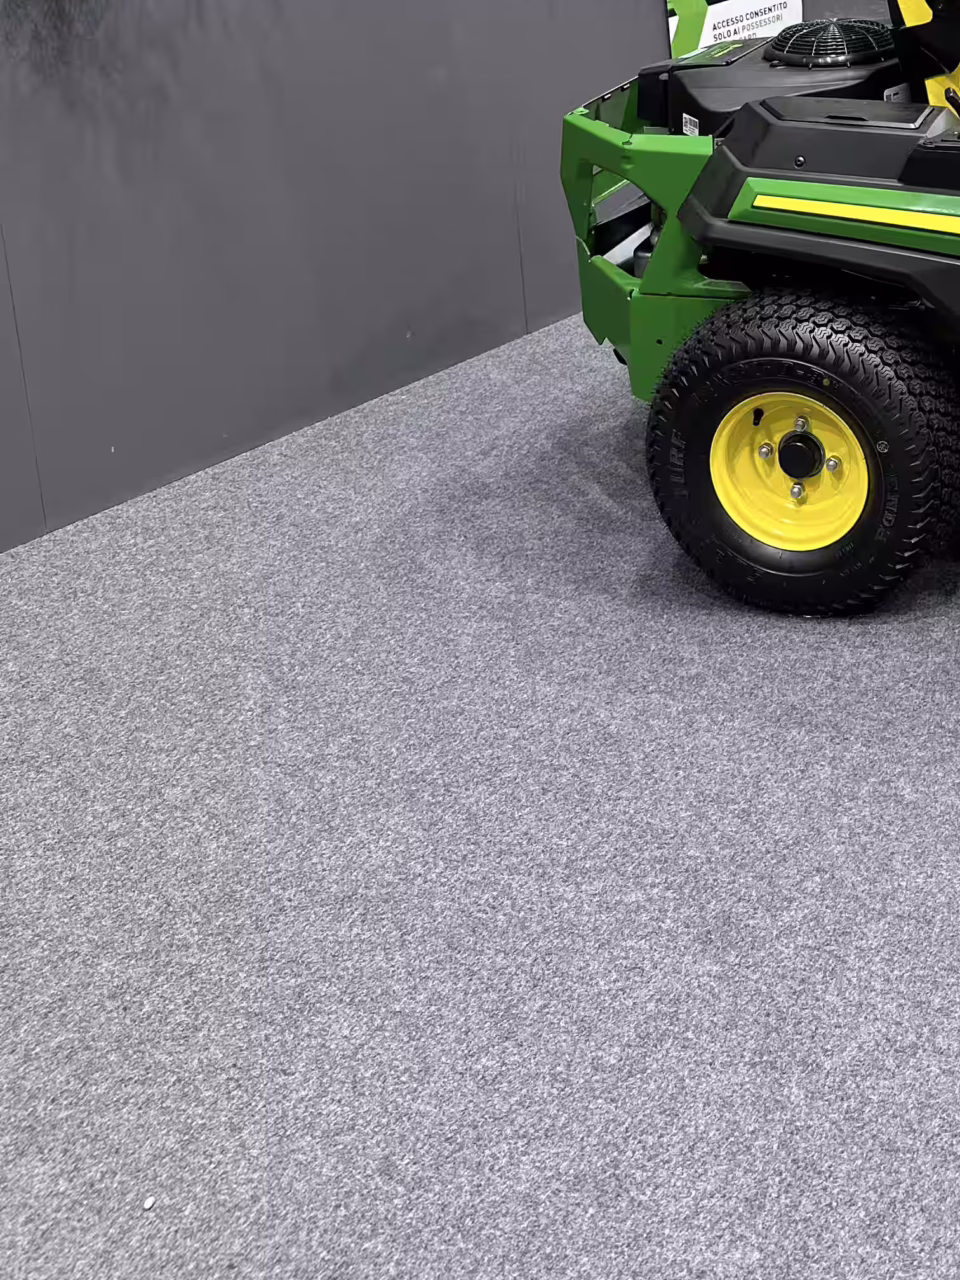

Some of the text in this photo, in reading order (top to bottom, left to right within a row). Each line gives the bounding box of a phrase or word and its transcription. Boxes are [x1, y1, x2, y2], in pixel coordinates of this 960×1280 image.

[712, 1, 788, 31] ACCESSO CONSENTITO
[713, 13, 783, 42] SOLO AI POSSESSORI
